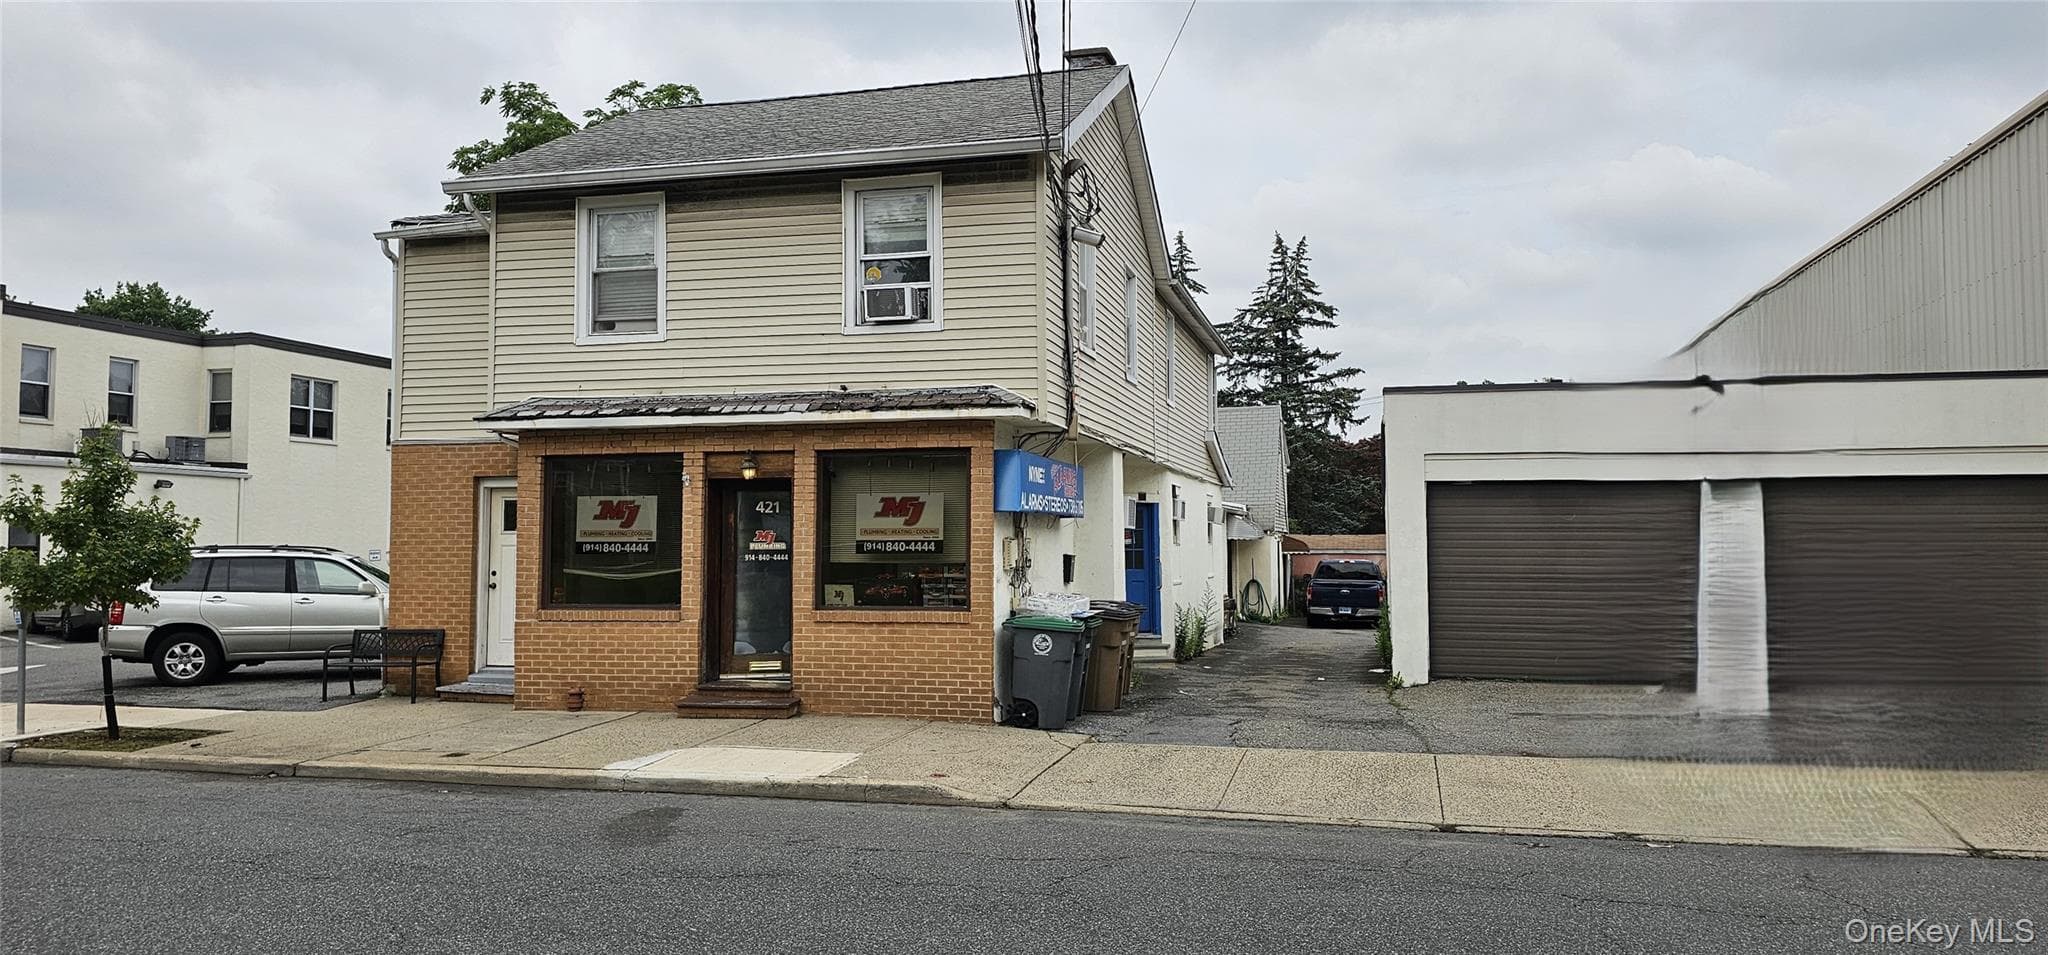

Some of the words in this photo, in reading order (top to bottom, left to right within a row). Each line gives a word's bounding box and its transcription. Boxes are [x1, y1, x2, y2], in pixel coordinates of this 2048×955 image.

[755, 501, 780, 513] 421
[873, 496, 927, 527] MJ
[592, 500, 641, 529] MJ
[582, 544, 602, 553] (914)
[602, 543, 649, 552] 840-4444
[863, 542, 885, 552] (914)
[885, 541, 936, 551] 840-4444
